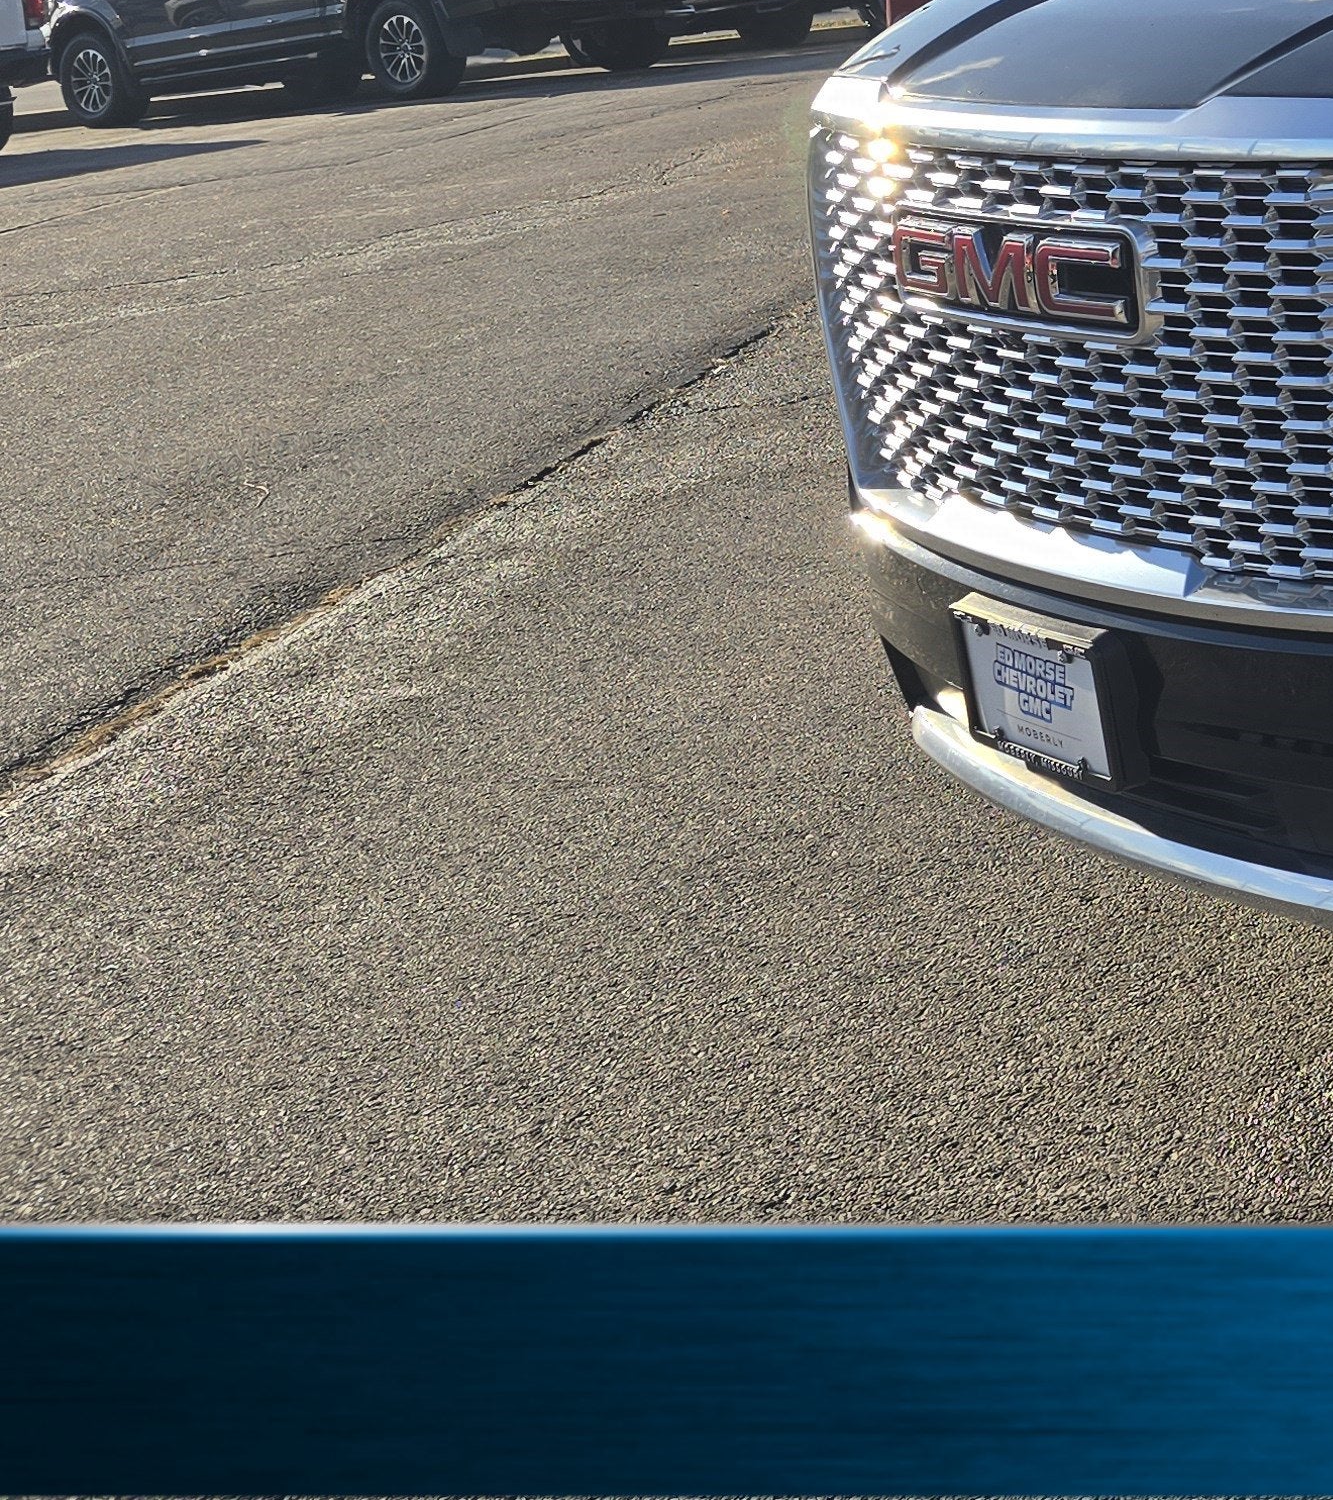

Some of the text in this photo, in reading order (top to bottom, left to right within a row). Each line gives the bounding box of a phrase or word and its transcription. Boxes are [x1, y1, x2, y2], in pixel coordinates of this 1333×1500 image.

[892, 216, 1129, 324] GMC
[993, 660, 1074, 710] CHEVROLET
[996, 642, 1014, 668] ED
[1013, 649, 1066, 687] MORSE
[1018, 691, 1052, 723] GMC
[1017, 724, 1063, 748] MOBERLY
